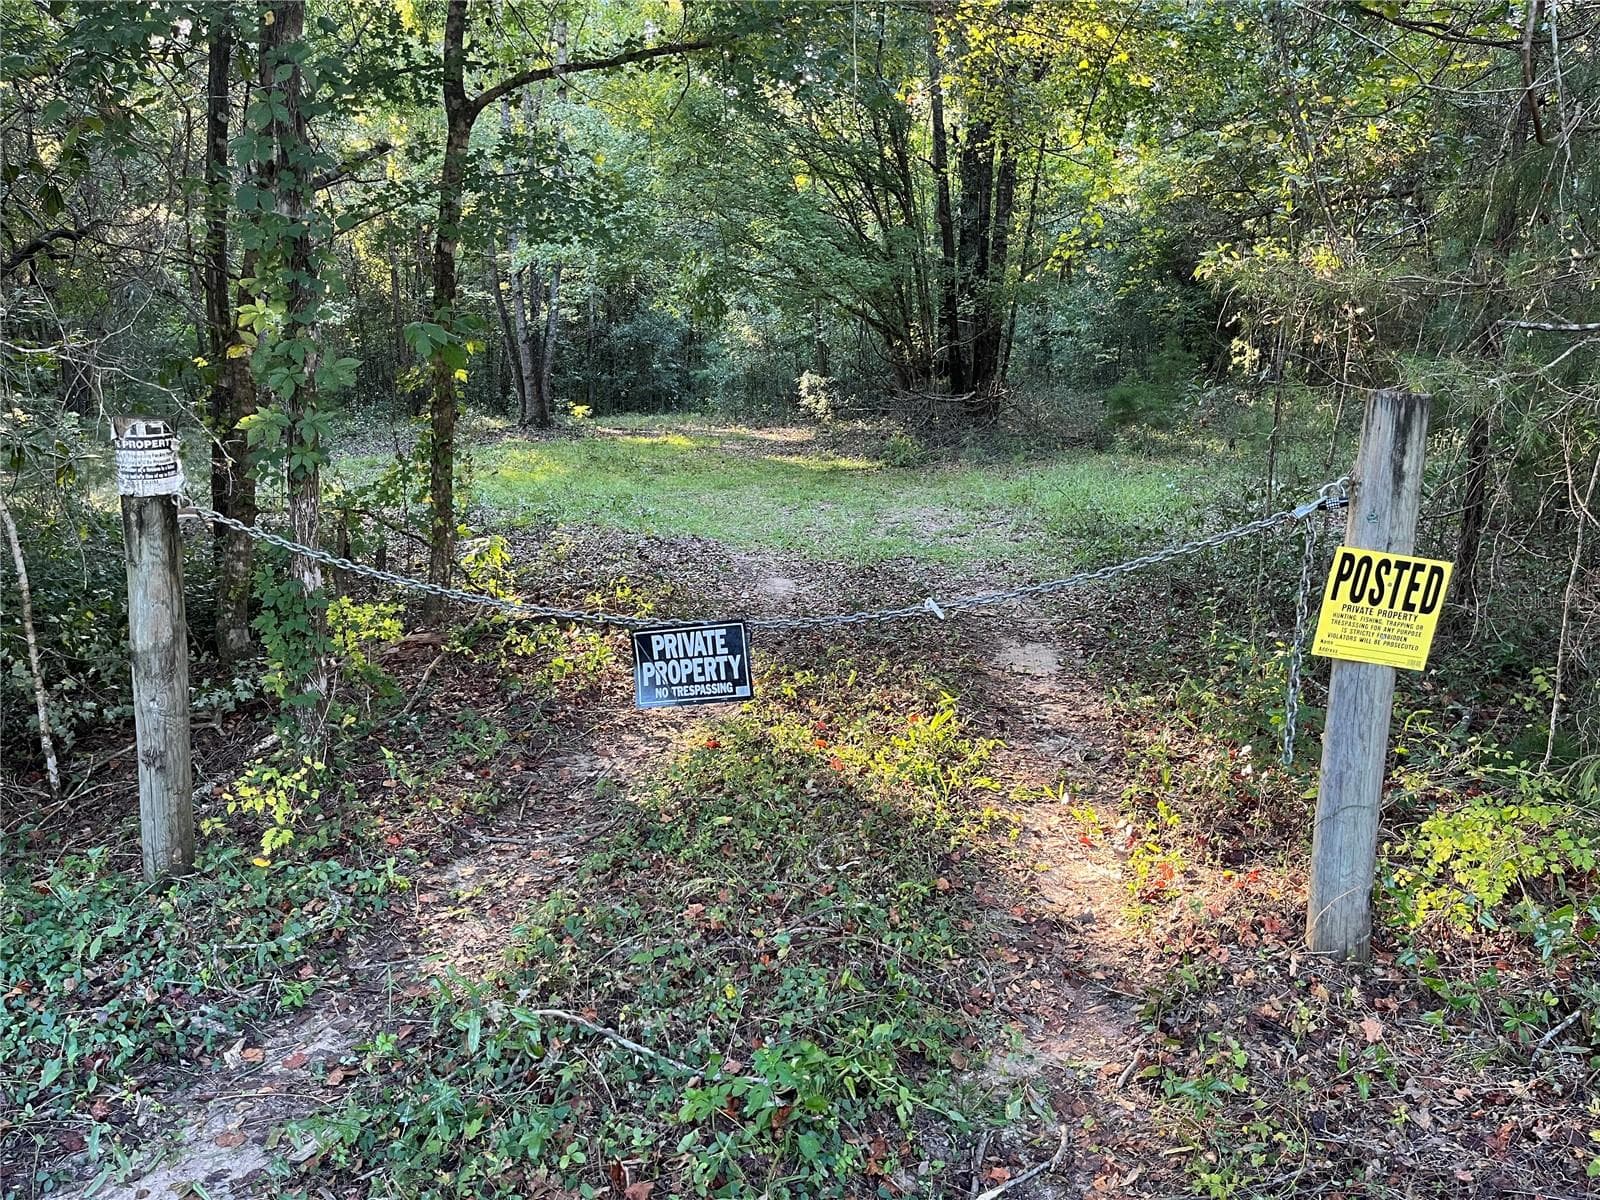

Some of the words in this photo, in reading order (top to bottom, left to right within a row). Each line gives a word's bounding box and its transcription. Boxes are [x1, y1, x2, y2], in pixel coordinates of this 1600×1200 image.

[1330, 552, 1444, 615] POSTED
[1342, 604, 1374, 616] PRIVATE
[1377, 609, 1419, 622] PROPERTY
[1331, 618, 1369, 630] TRESPASSING
[1396, 628, 1422, 638] PURPOSE
[1349, 628, 1375, 637] STRICTLY
[1387, 620, 1414, 630] TRAPPING
[651, 629, 728, 660] PRIVATE
[1327, 632, 1357, 642] VIOLATORS
[1359, 637, 1372, 645] WILL
[1383, 640, 1419, 651] PROSECUTED
[642, 655, 741, 686] PROPERTY
[655, 687, 669, 699] NO
[671, 682, 733, 697] TRESPASSING
